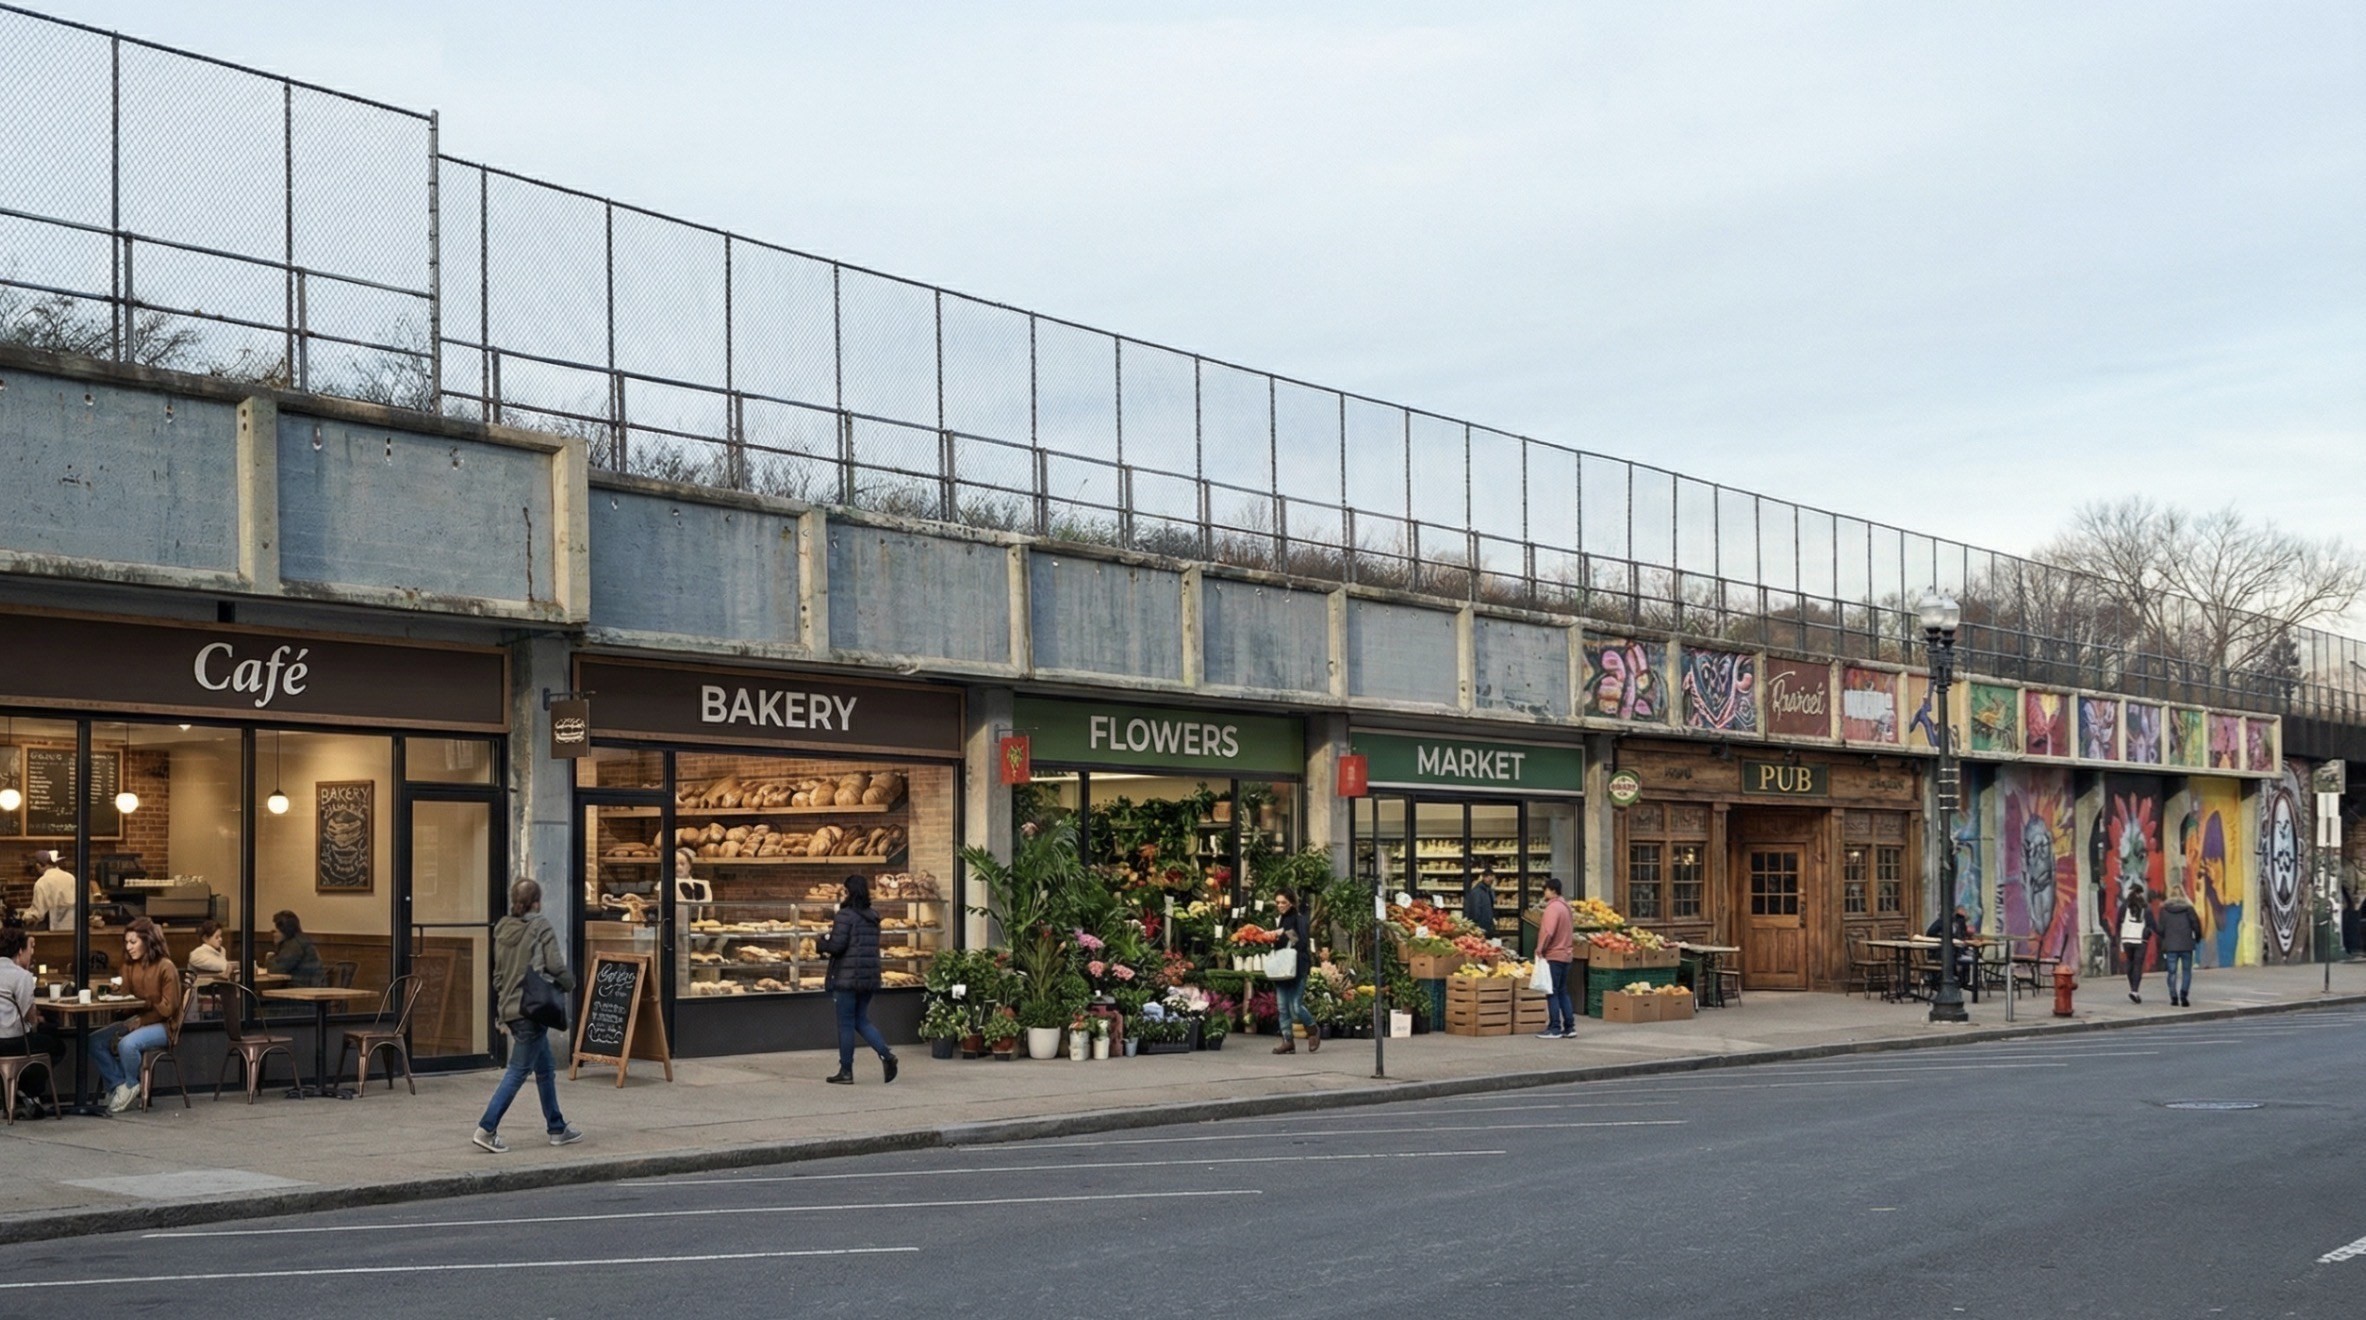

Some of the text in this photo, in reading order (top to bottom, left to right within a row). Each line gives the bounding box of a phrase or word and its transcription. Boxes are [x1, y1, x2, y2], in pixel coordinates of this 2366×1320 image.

[194, 642, 309, 708] Café
[701, 684, 858, 731] BAKERY
[1090, 715, 1239, 758] FLOWERS
[1417, 745, 1526, 780] MARKET
[1758, 764, 1813, 792] PUB
[320, 786, 370, 805] BAKERY
